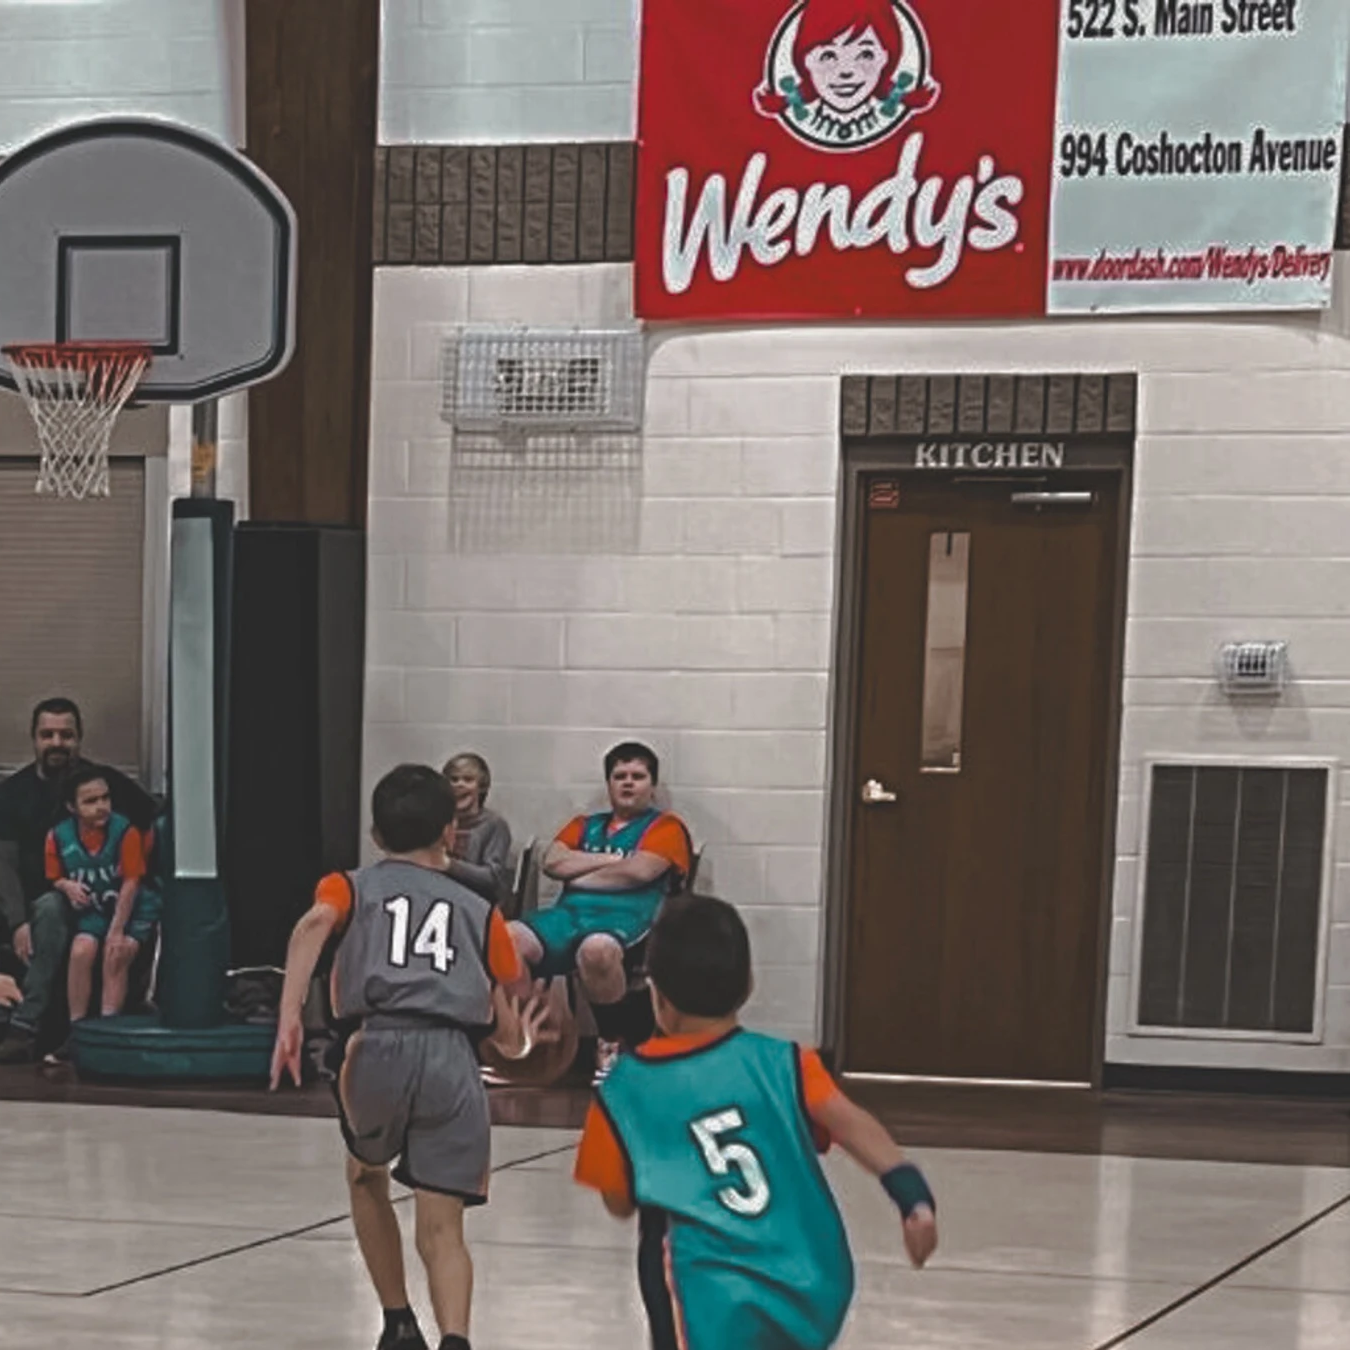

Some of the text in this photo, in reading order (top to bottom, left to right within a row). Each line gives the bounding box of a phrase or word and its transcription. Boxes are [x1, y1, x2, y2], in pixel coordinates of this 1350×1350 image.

[1067, 0, 1296, 38] 522 S. Main Street
[1060, 127, 1337, 177] 994 Coshocton Avenue
[663, 131, 1024, 294] Wendy's
[914, 442, 1065, 469] KITCHEN
[385, 896, 455, 972] 14
[689, 1107, 770, 1216] 5
